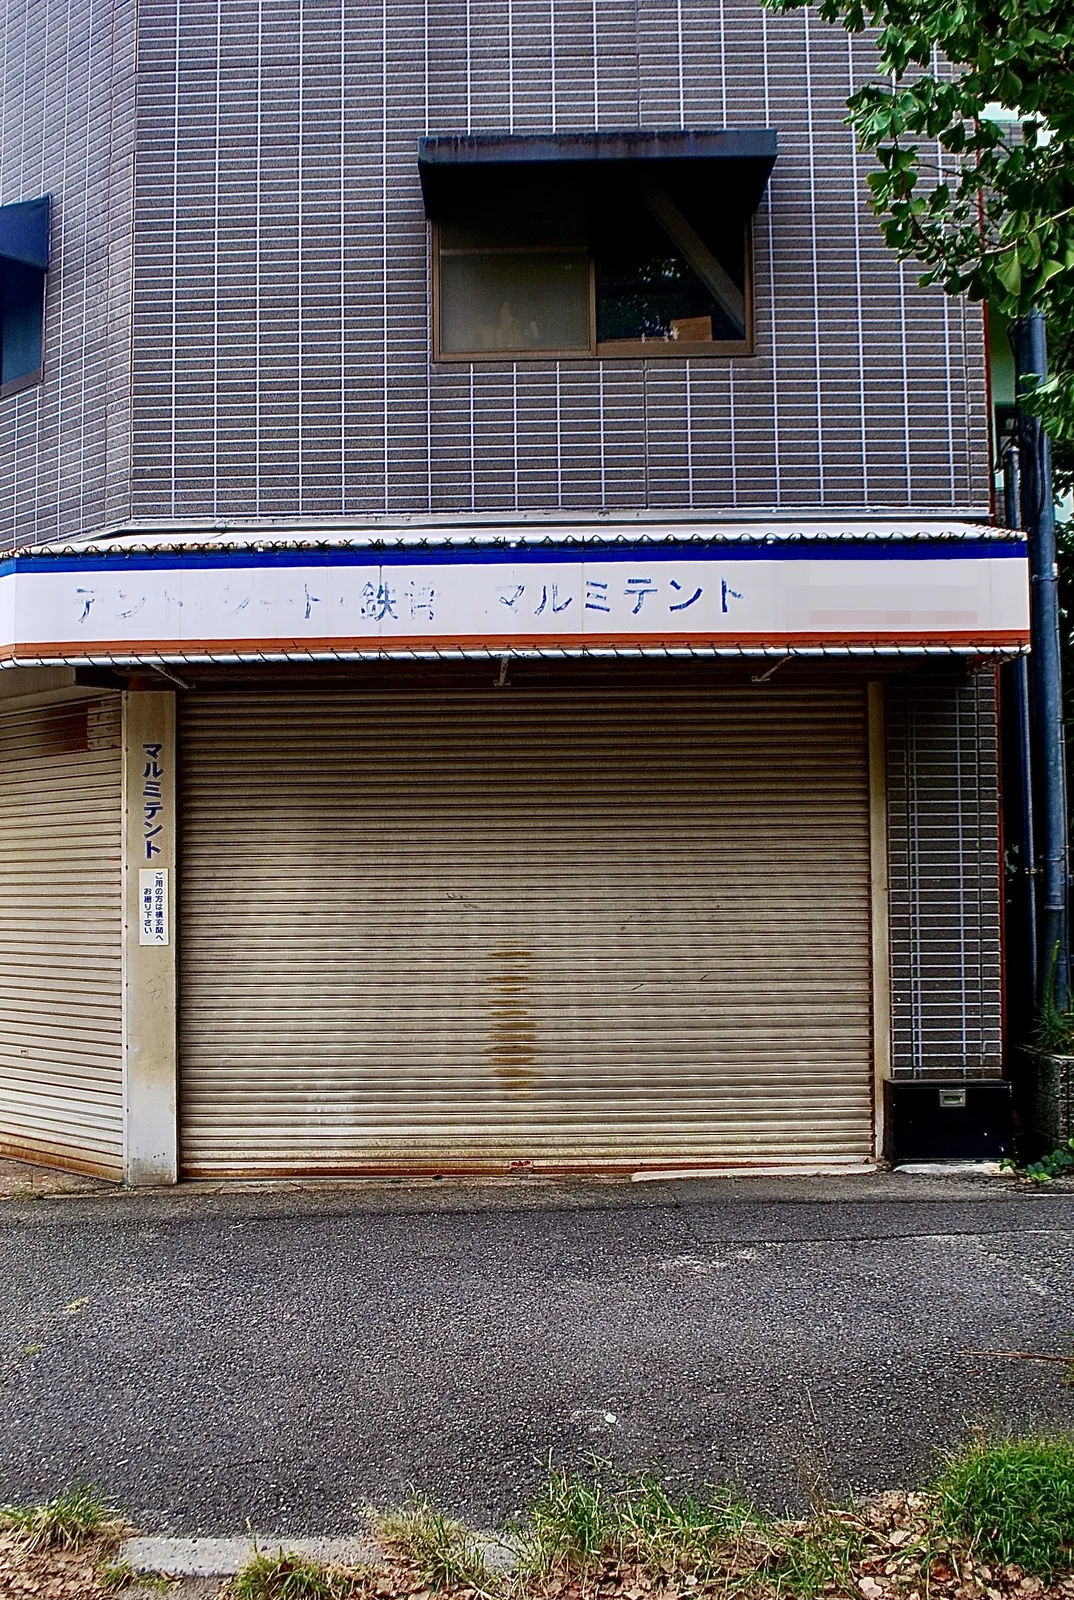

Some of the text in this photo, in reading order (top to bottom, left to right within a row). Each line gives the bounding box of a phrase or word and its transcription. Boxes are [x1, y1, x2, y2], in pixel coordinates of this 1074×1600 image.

[496, 578, 745, 616] マルミテント
[142, 744, 164, 859] マルミテント
